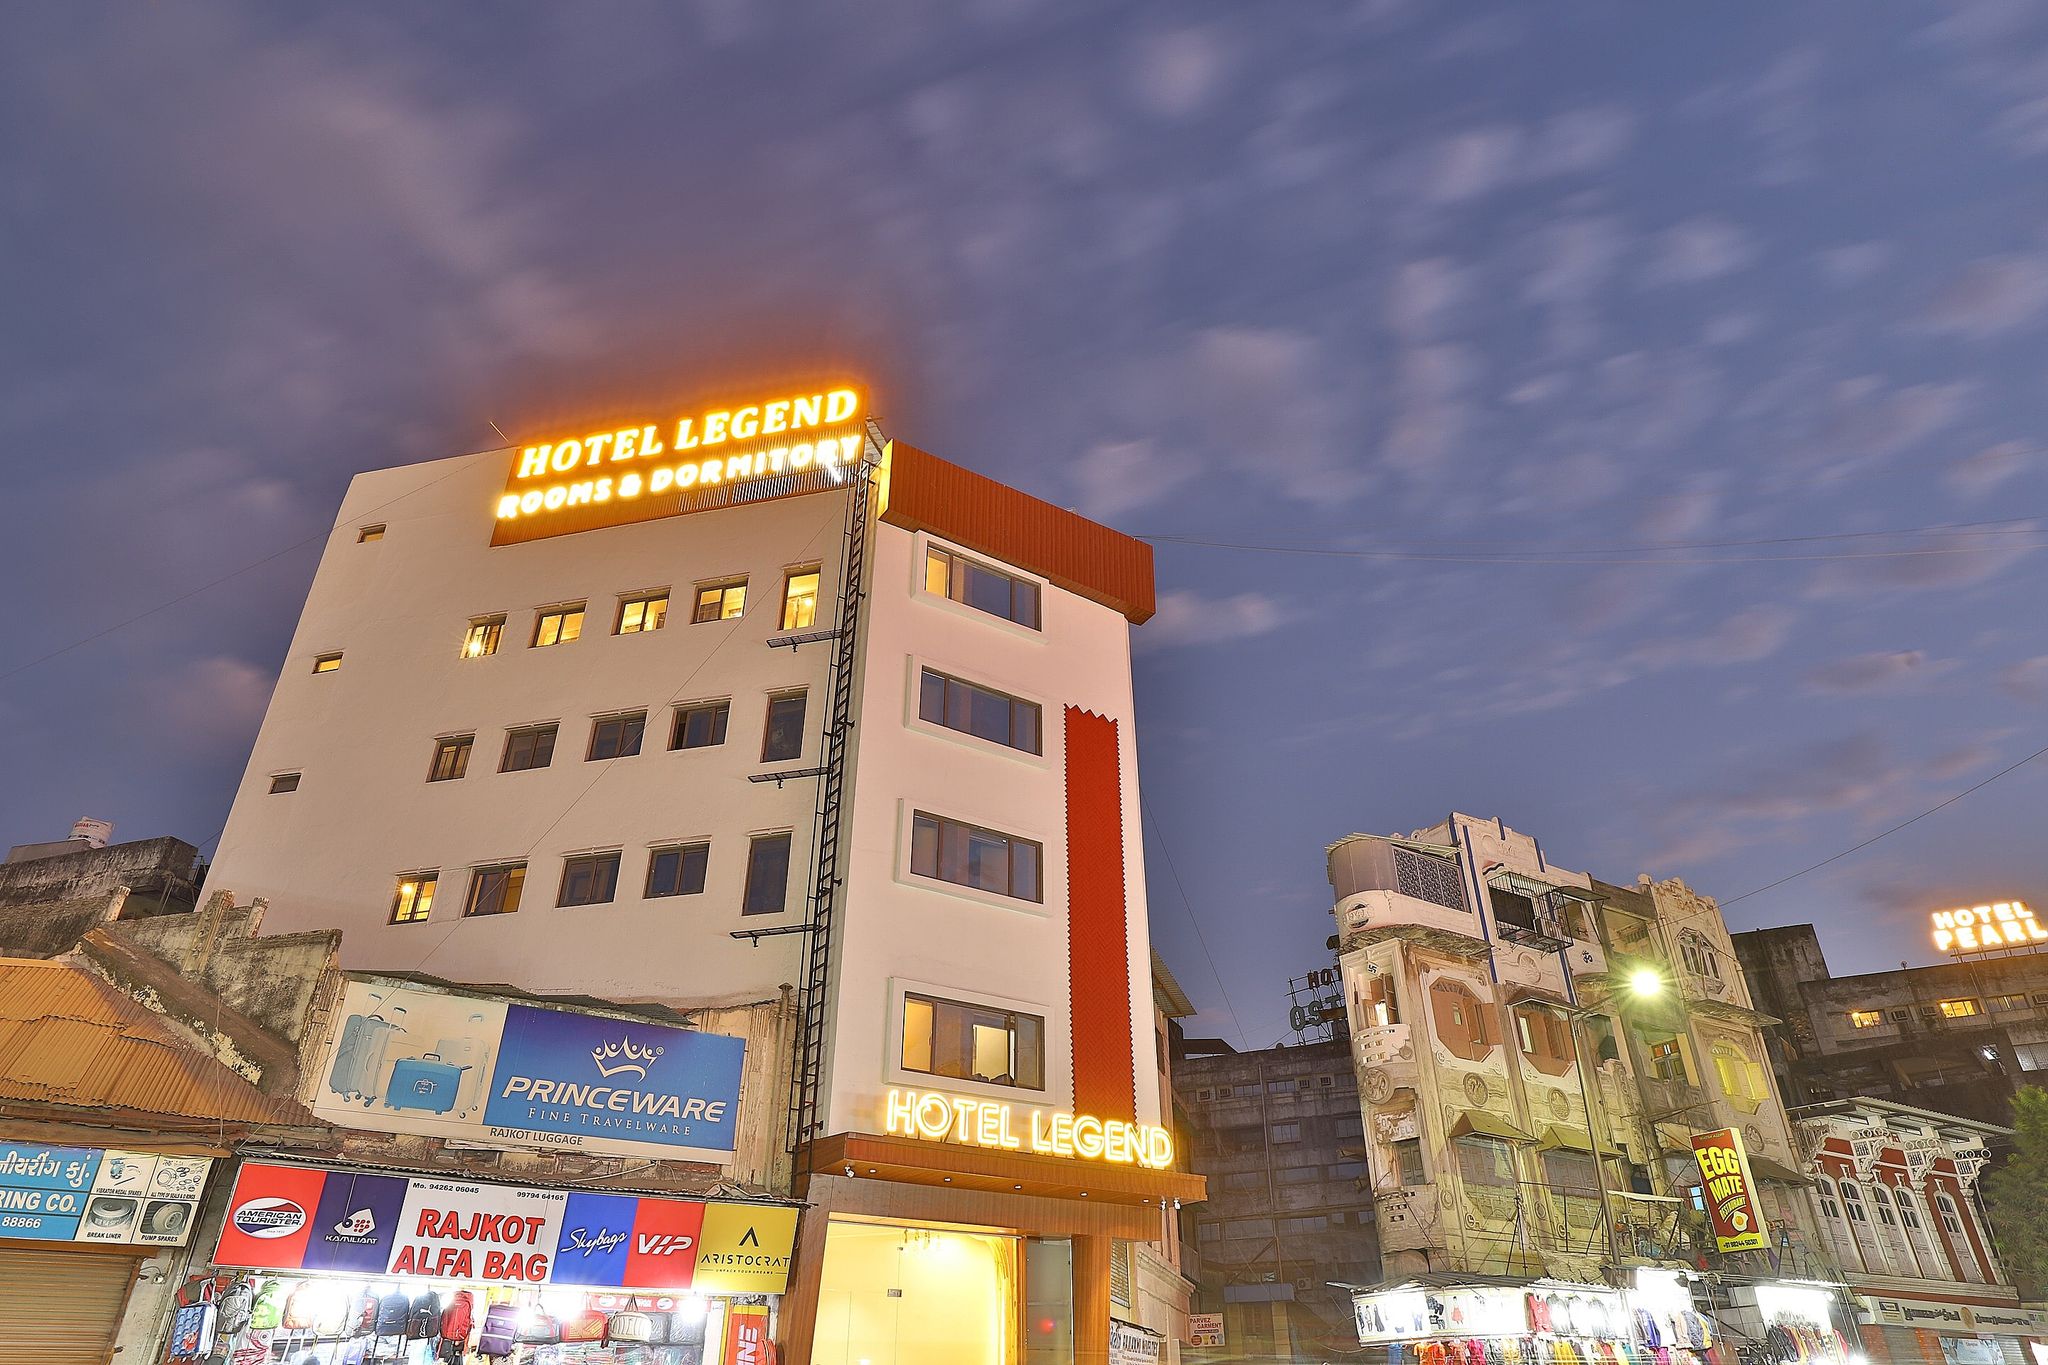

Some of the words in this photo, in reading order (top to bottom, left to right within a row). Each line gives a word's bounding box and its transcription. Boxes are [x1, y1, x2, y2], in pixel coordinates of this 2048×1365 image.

[517, 424, 663, 479] HOTEL
[673, 389, 859, 451] LEGEND
[496, 477, 612, 520] ROOMS
[618, 473, 642, 498] &
[650, 434, 861, 493] DORMITORY
[1932, 901, 2034, 929] HOTEL
[1933, 919, 2048, 951] PEARL
[501, 1076, 728, 1123] PRINCEWARE
[528, 1107, 571, 1122] FINE
[580, 1113, 691, 1136] TRAVELWARE
[886, 1088, 1019, 1148] HOTEL
[1031, 1109, 1174, 1168] LEGEND
[490, 1127, 531, 1141] RAJKOT
[532, 1131, 583, 1147] LUGGAGE
[1695, 1146, 1741, 1181] EGG
[412, 1182, 427, 1190] Mo.
[429, 1183, 454, 1192] 94262
[516, 1191, 539, 1199] 99794
[541, 1193, 564, 1201] 64165
[1708, 1175, 1744, 1204] MATE
[45, 1193, 77, 1213] CO.
[238, 1210, 302, 1219] AMERICAN
[2, 1216, 42, 1228] 88866
[87, 1231, 104, 1239] BREAK
[415, 1208, 546, 1245] RAJKOT
[325, 1235, 378, 1245] KAMILIANT
[560, 1227, 628, 1257] Skybags
[638, 1233, 693, 1256] VIP
[391, 1245, 473, 1279] ALFA
[482, 1250, 548, 1282] BAG
[701, 1254, 790, 1268] ARISTOCRAT
